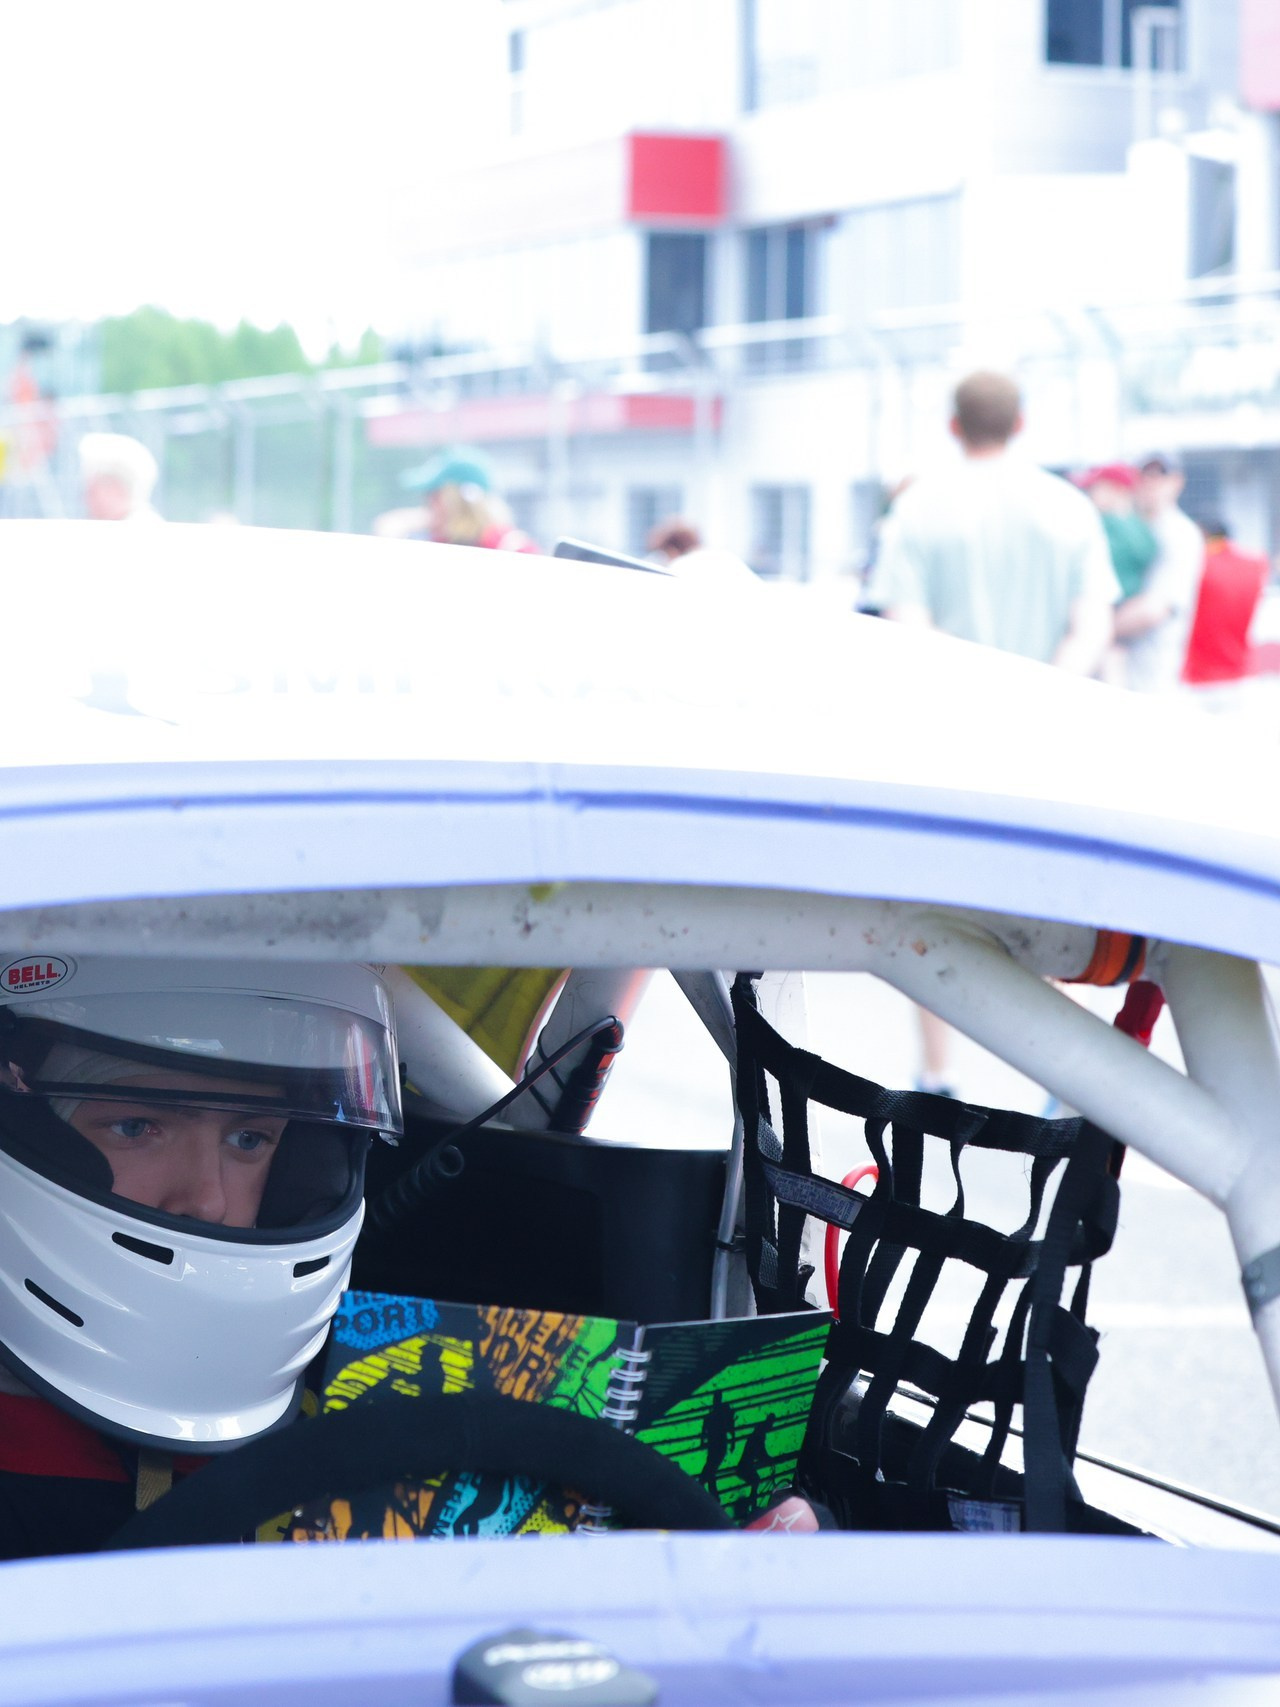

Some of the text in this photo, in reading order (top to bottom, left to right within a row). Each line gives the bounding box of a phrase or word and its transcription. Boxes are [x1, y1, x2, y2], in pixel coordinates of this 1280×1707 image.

[7, 962, 60, 985] BELL
[13, 979, 51, 990] HELMETS
[332, 1302, 424, 1336] PORT
